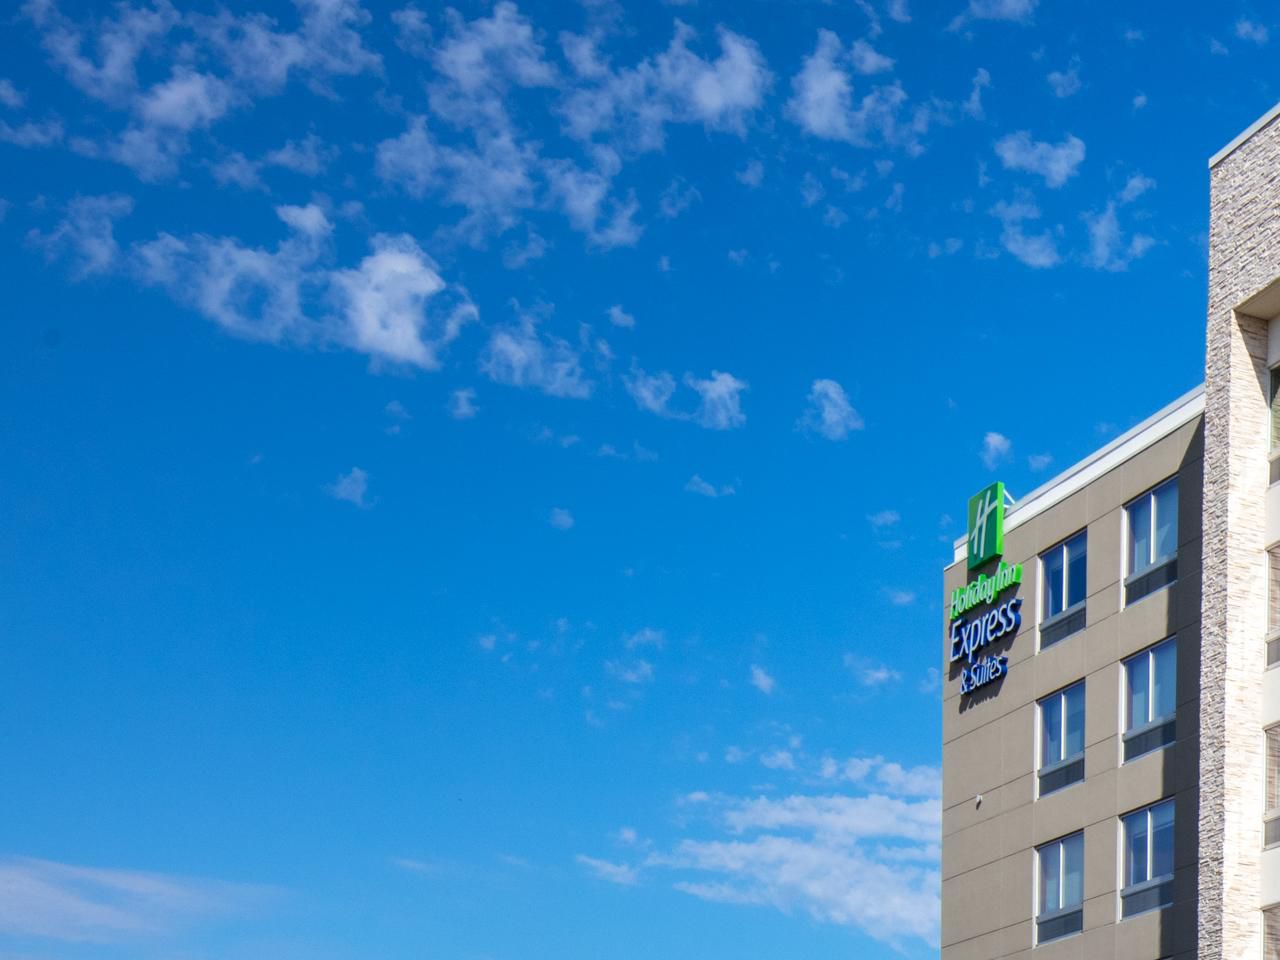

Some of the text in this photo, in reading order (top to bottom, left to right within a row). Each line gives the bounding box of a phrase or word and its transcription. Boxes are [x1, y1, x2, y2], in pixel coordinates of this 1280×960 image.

[950, 561, 1022, 619] Holiday Inn
[950, 599, 1018, 663] Express
[960, 657, 1004, 695] & Suites
